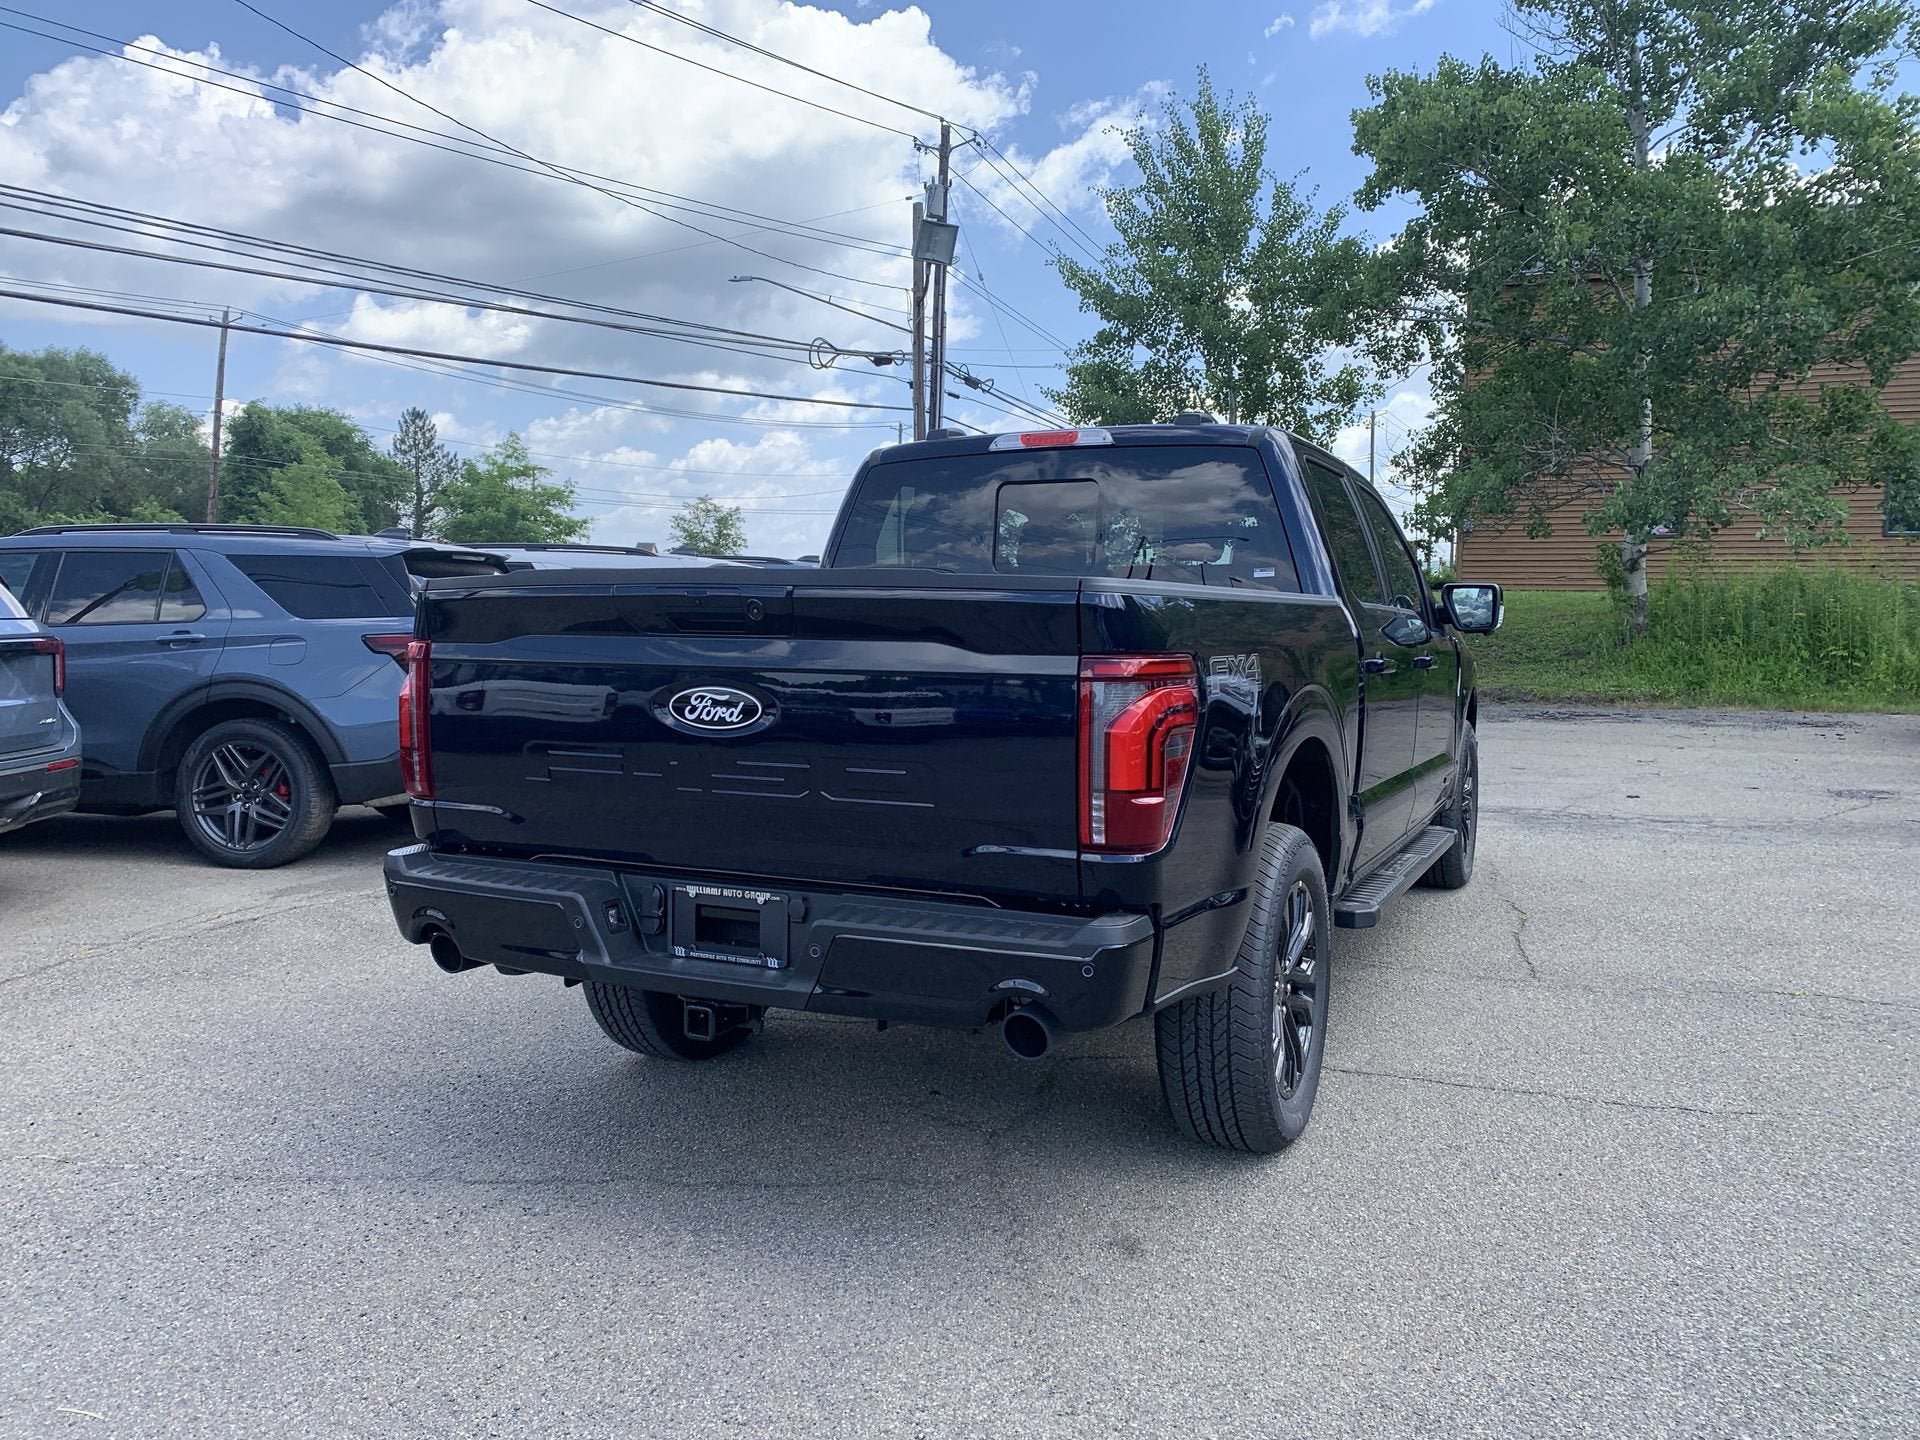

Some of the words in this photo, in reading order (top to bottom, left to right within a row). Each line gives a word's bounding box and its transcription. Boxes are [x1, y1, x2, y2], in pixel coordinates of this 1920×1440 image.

[1207, 653, 1262, 696] FX4
[684, 692, 745, 723] Ford
[723, 888, 742, 898] AUTO
[737, 957, 762, 965] COMMUNITY
